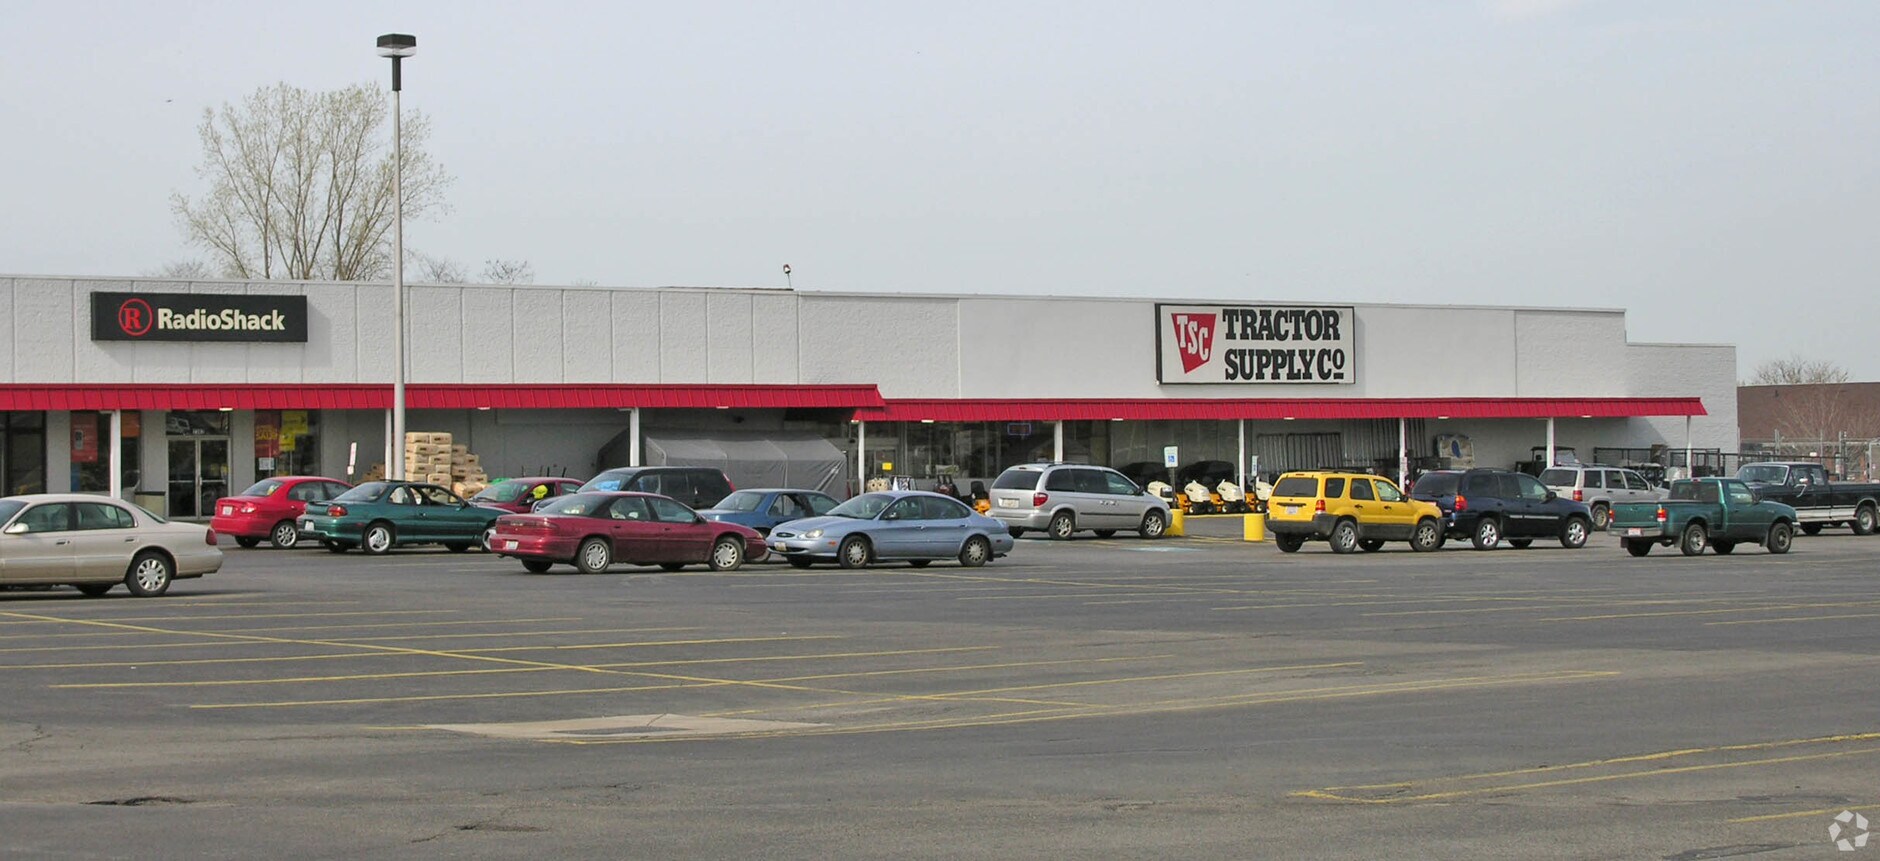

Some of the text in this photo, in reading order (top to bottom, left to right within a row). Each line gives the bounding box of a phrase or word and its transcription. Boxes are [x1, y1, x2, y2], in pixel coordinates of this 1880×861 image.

[157, 308, 285, 330] RadioShack
[1222, 309, 1340, 341] TRACTOR
[1176, 314, 1209, 362] TSC
